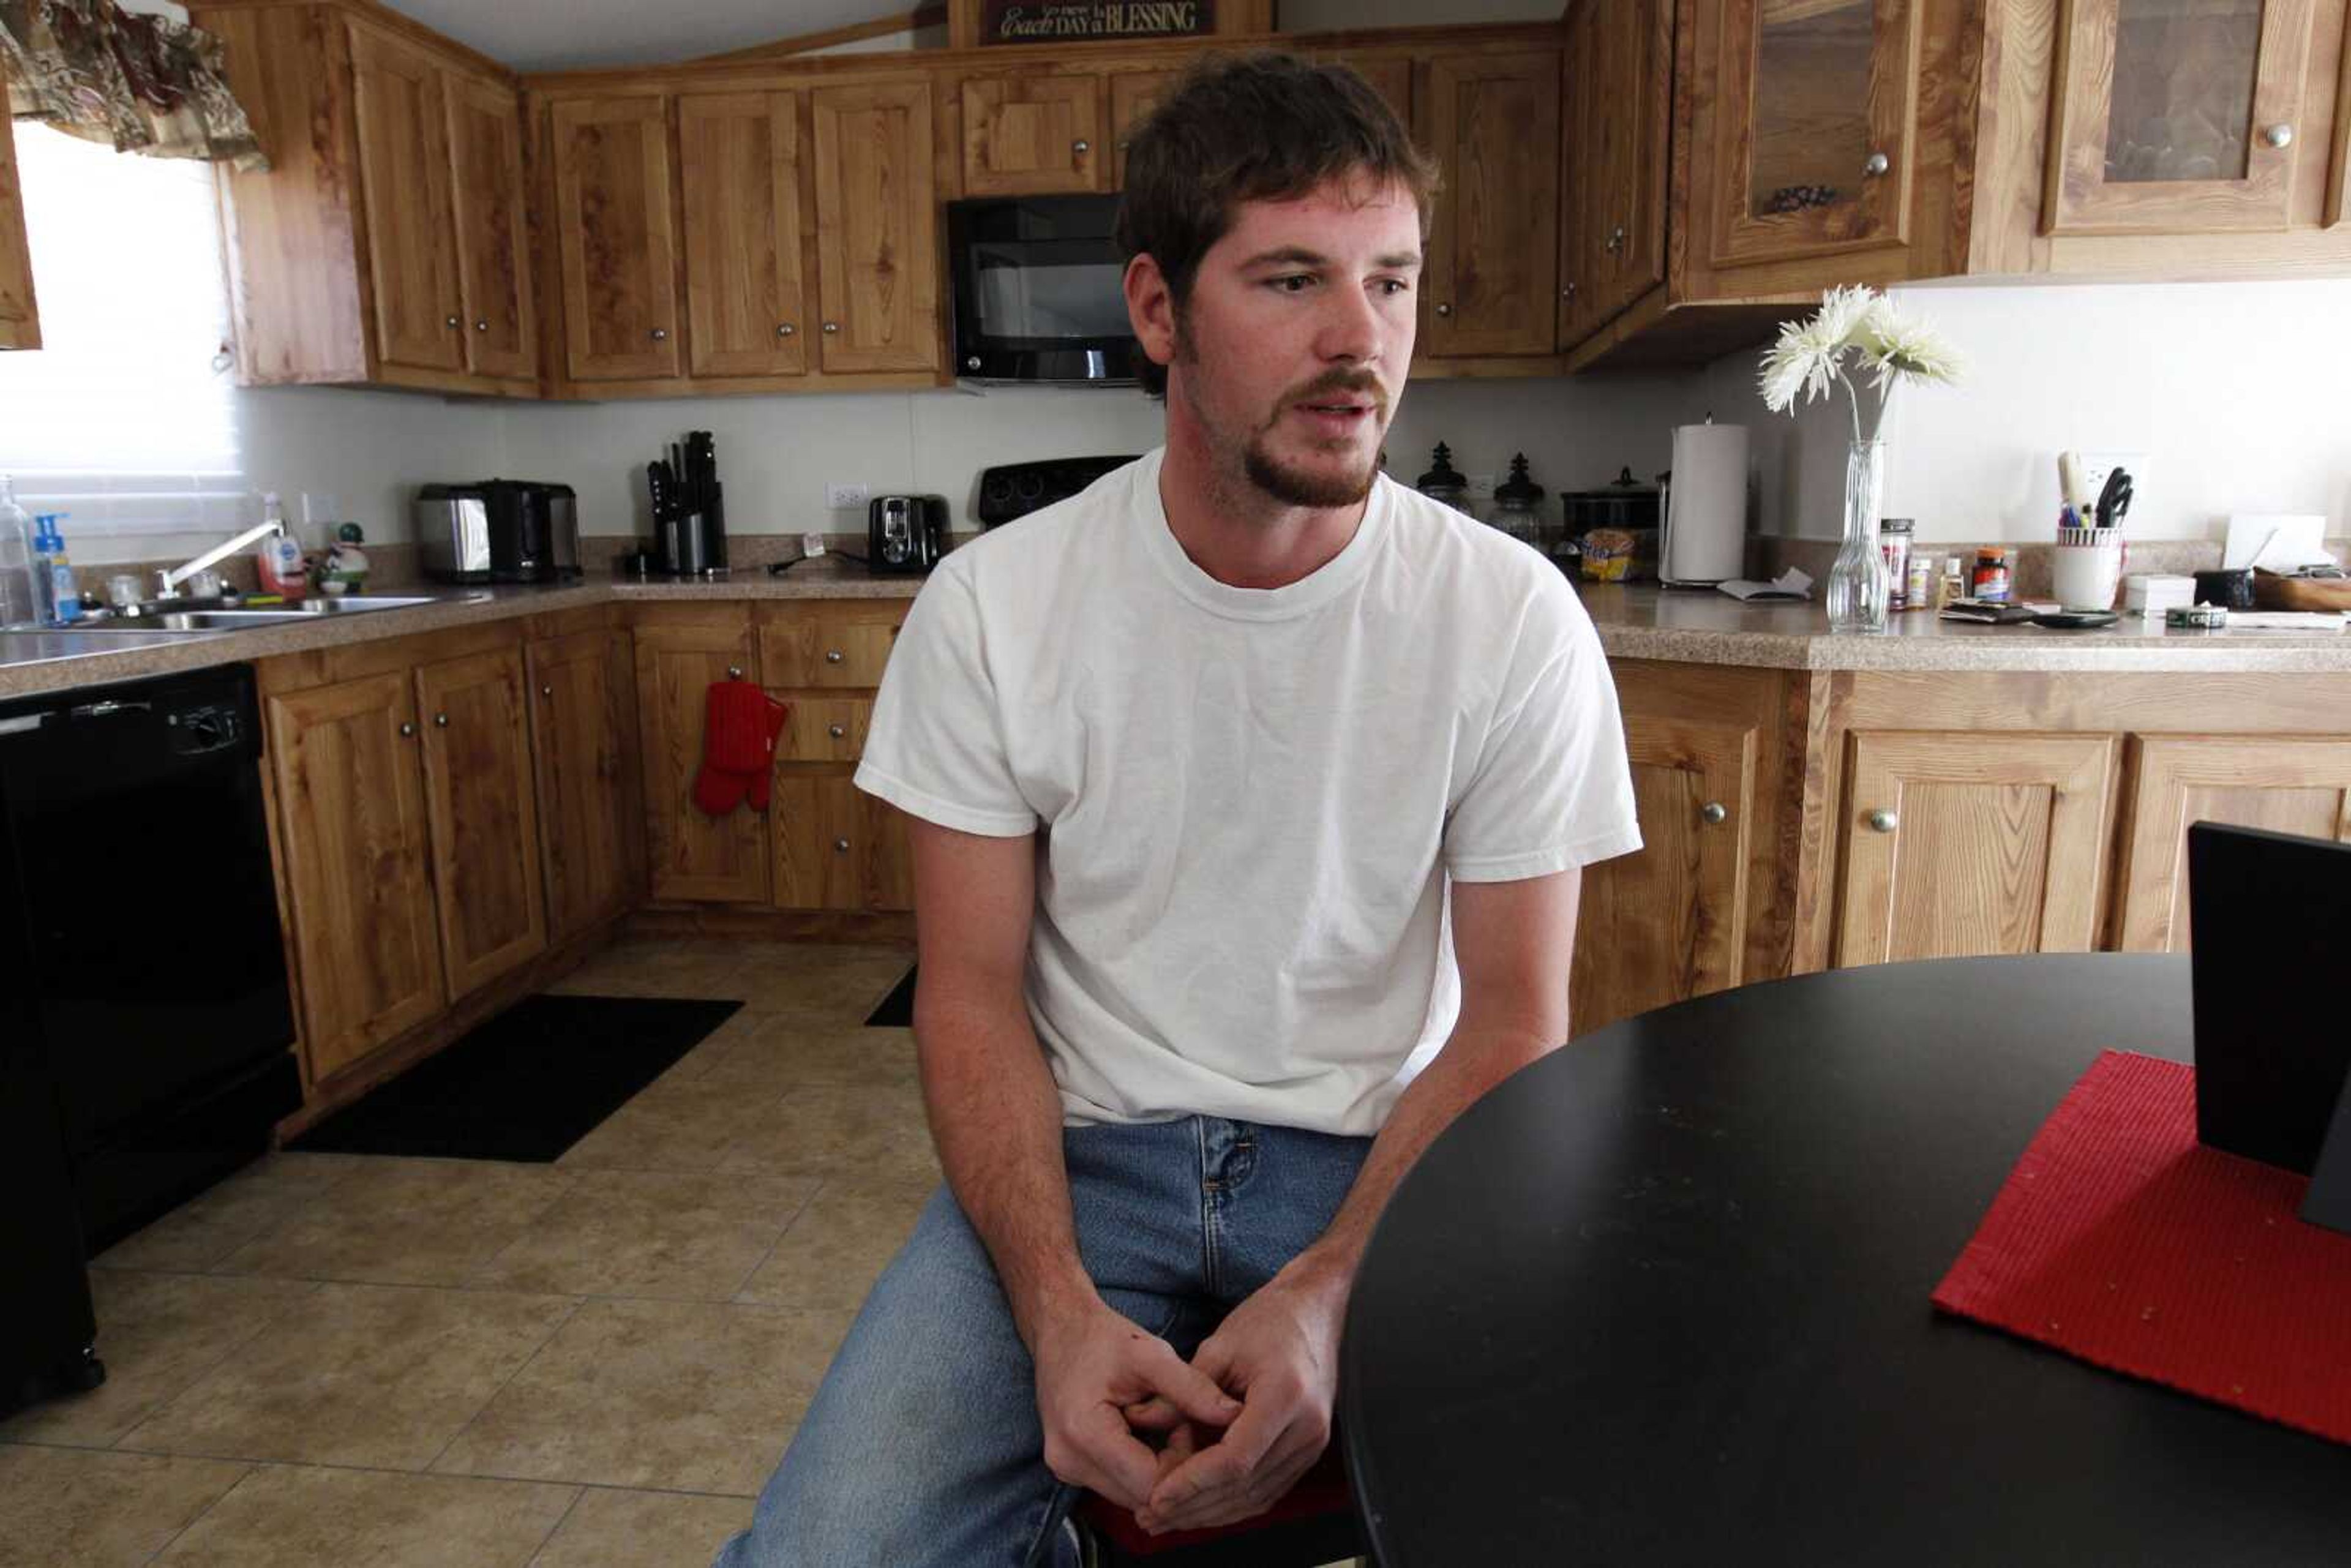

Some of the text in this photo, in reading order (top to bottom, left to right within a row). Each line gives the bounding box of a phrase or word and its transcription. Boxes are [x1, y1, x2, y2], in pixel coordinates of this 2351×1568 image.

[1000, 6, 1056, 38] Each
[1057, 17, 1090, 35] DAY
[1105, 1, 1196, 33] BLESSING
